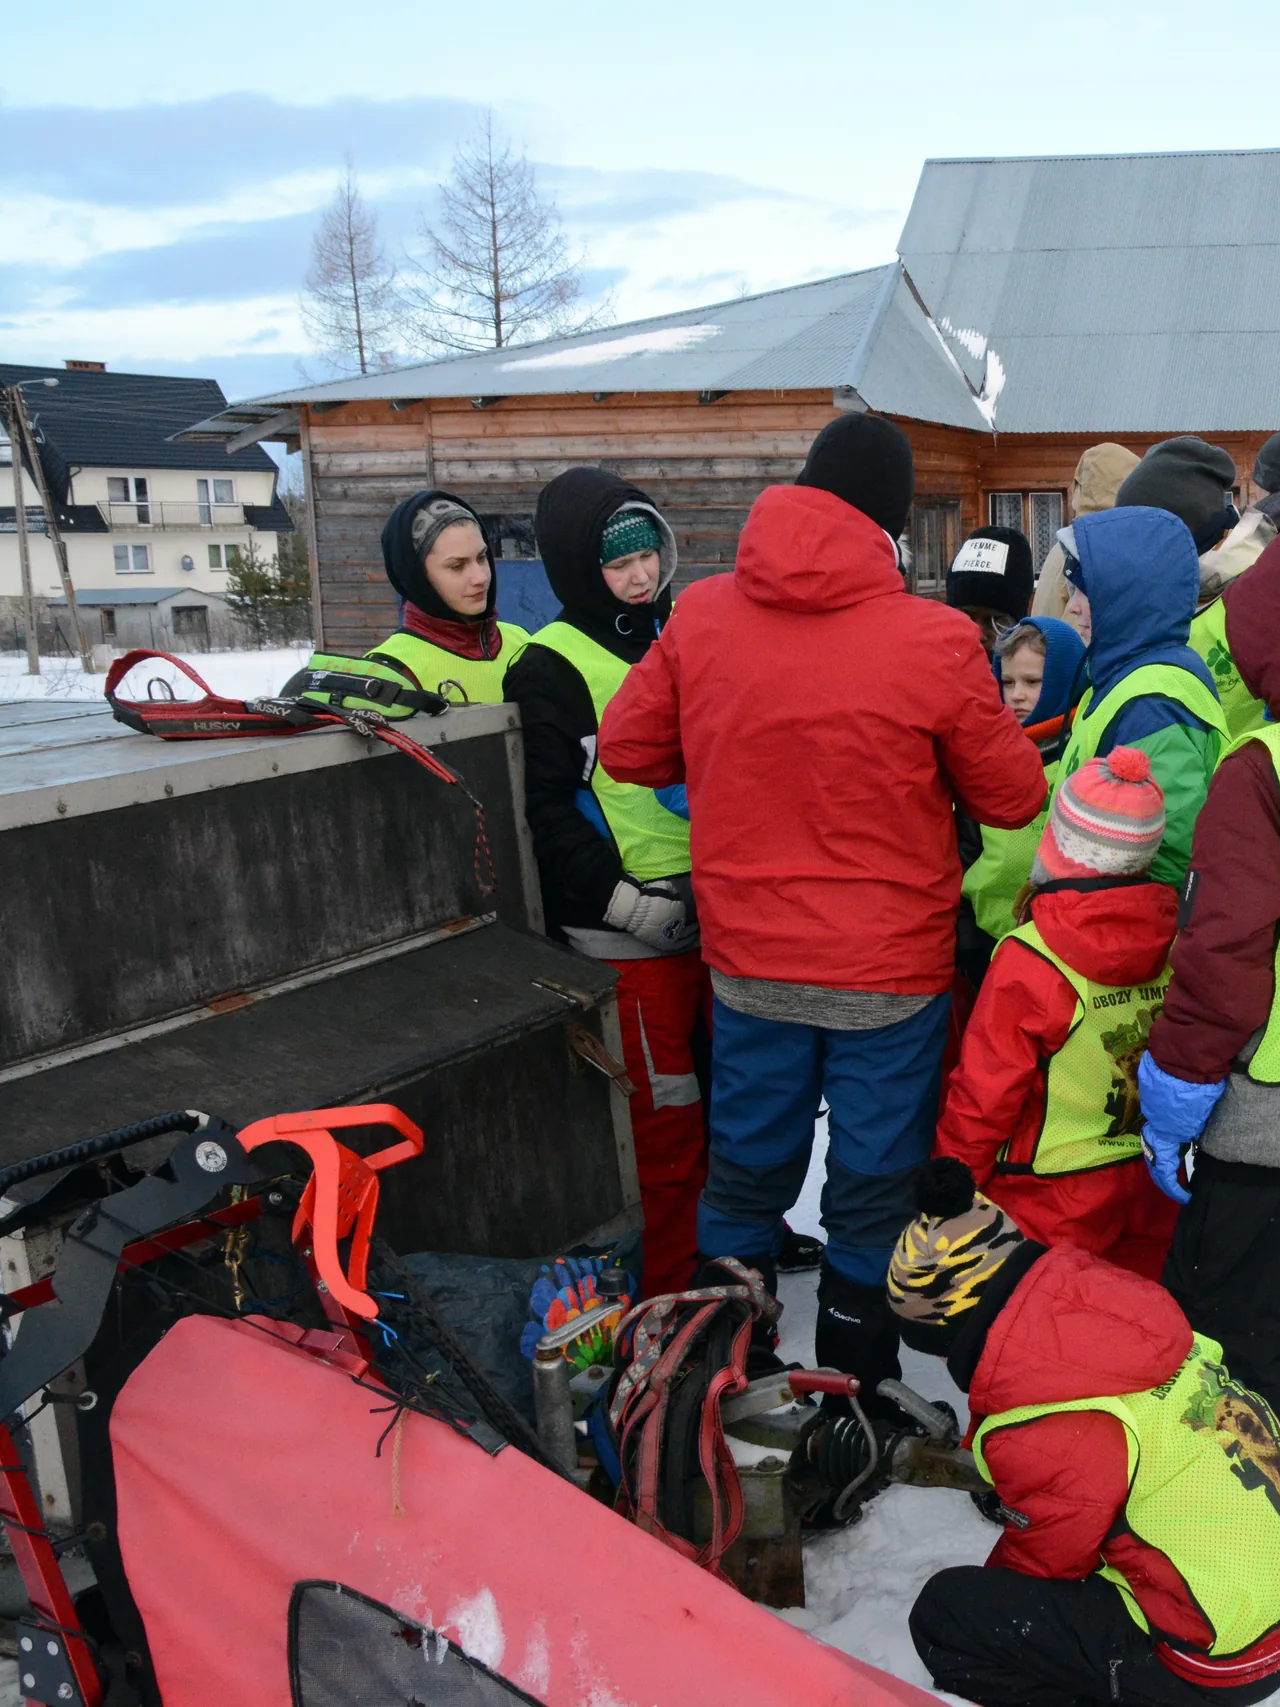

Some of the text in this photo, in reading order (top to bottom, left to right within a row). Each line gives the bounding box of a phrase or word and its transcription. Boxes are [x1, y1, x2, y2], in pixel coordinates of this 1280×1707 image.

[970, 542, 997, 551] FEMME
[963, 560, 992, 569] FIERCE
[253, 702, 291, 717] HUSKY
[193, 721, 241, 731] HUSKY
[1092, 989, 1132, 1010] OBOZY
